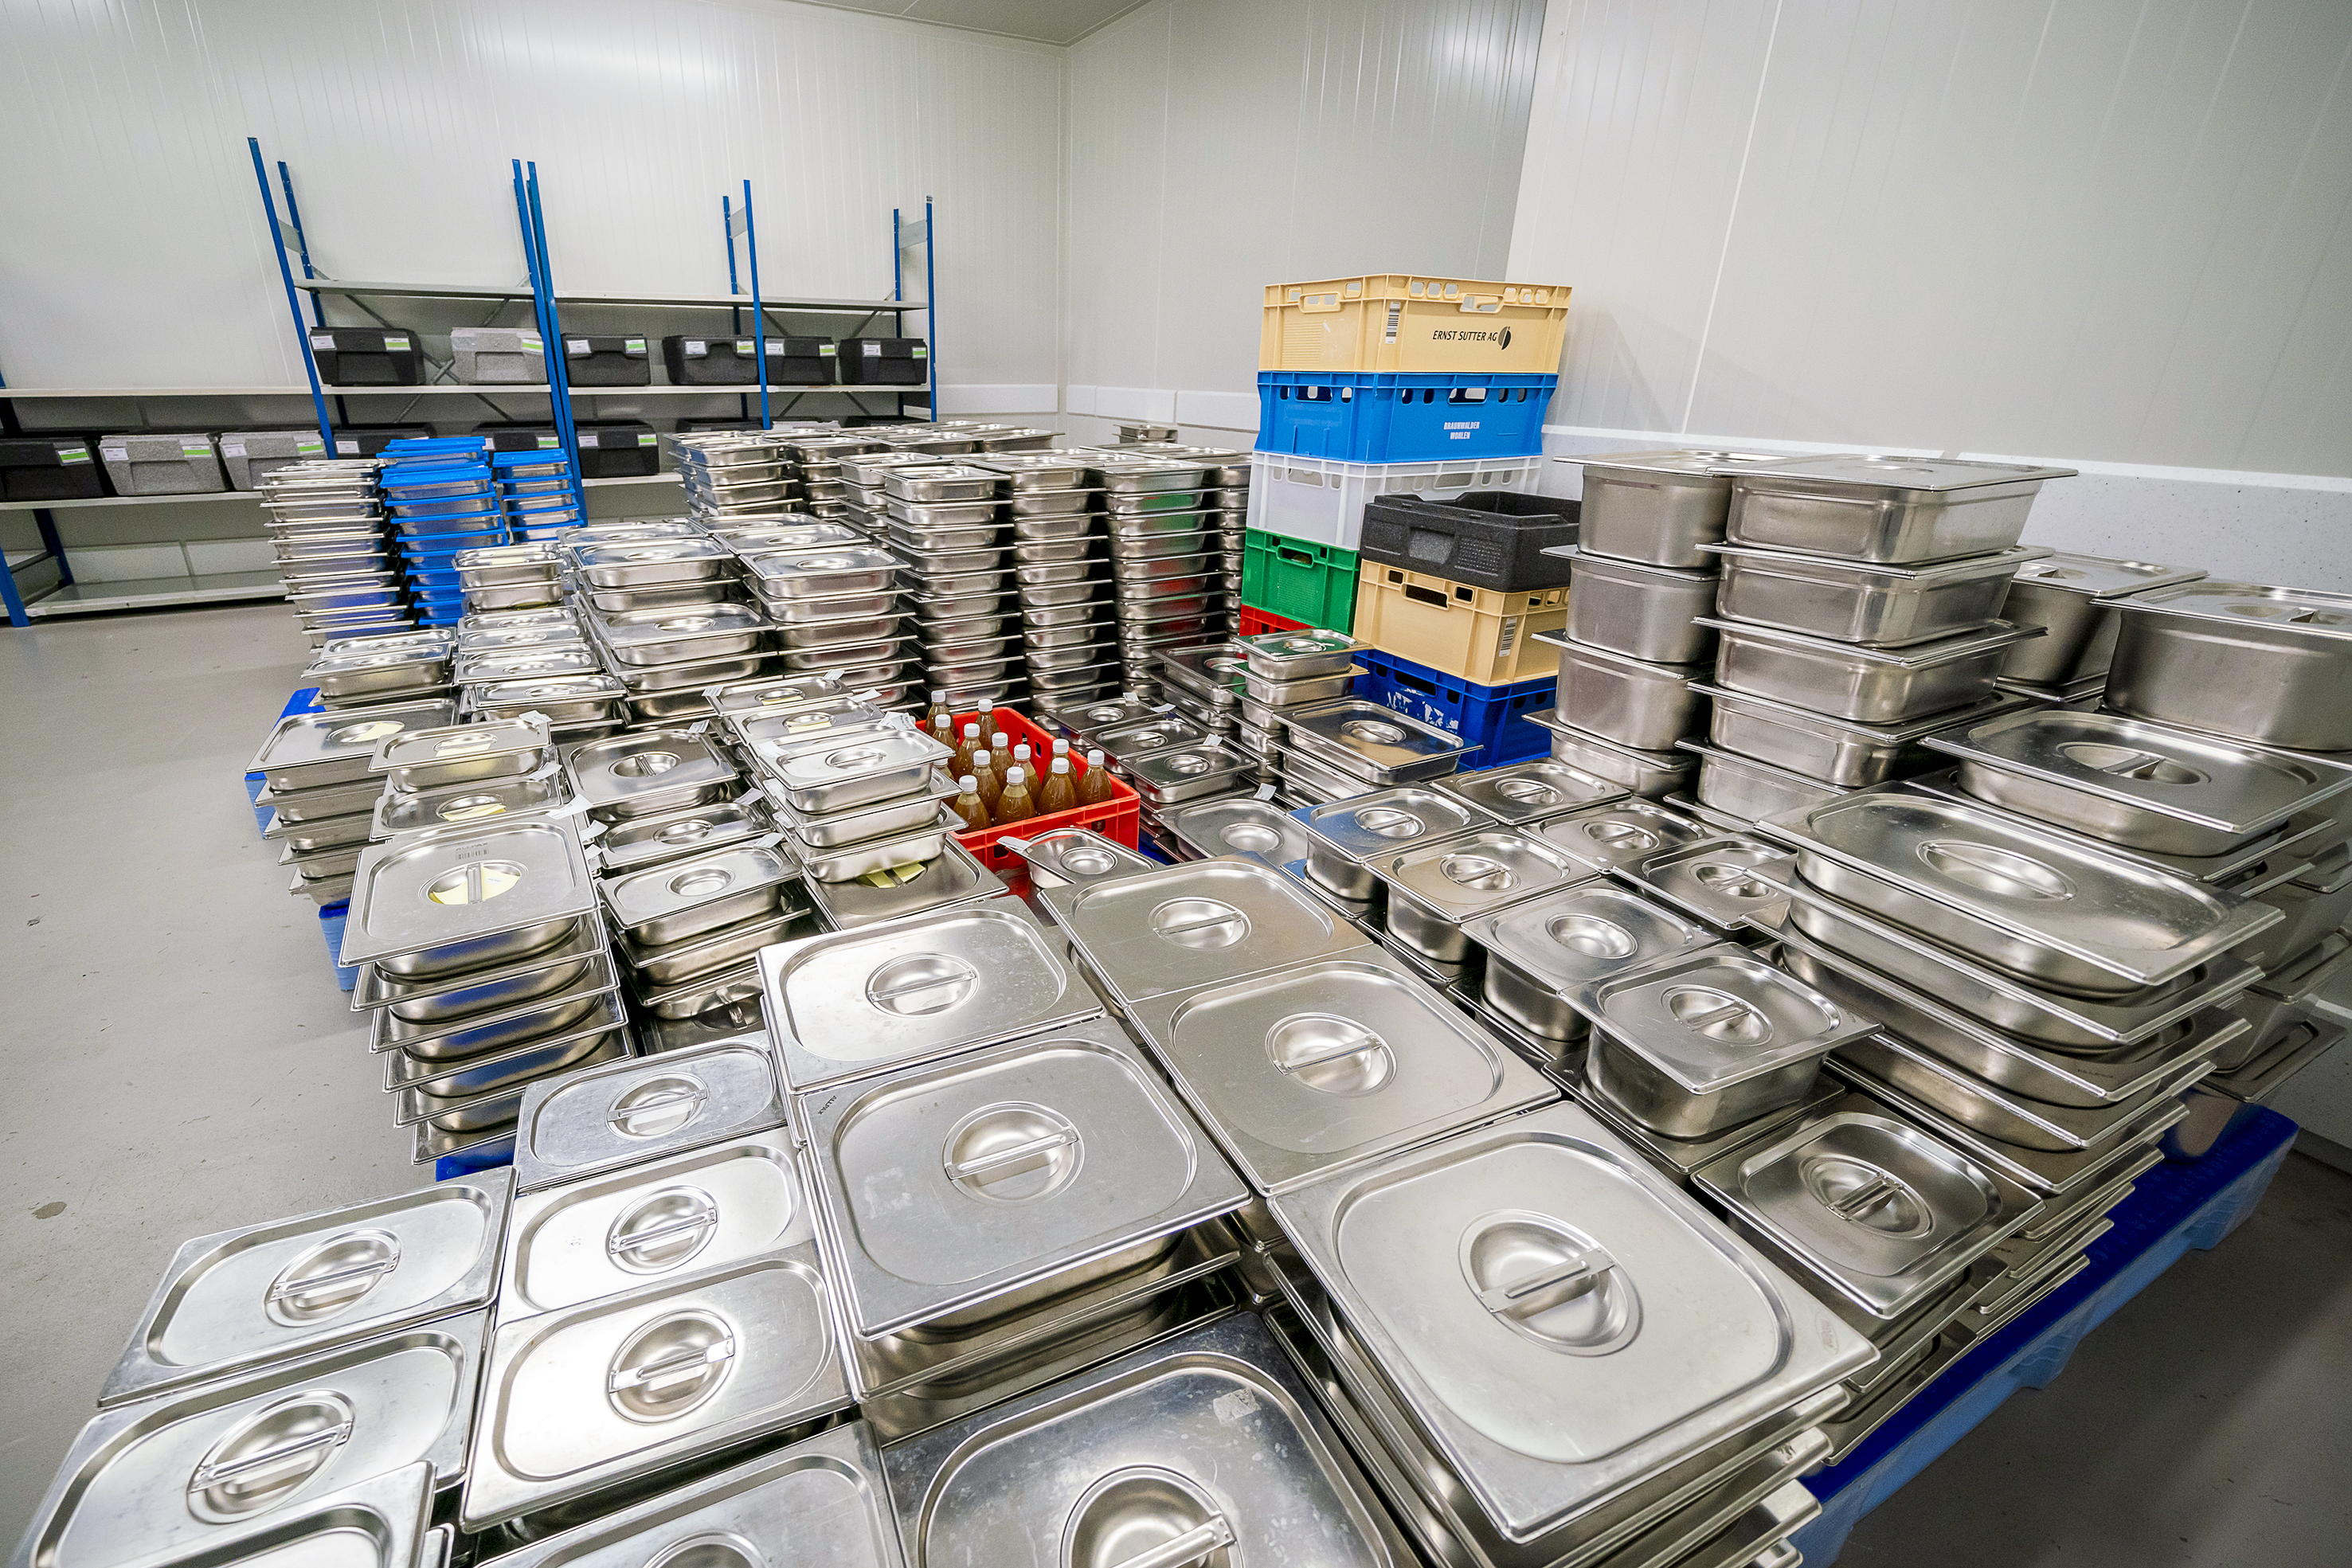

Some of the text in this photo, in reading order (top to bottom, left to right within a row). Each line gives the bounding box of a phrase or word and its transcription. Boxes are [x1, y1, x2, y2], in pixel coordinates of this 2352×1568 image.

[1432, 330, 1498, 342] ERNST SUTTER AG
[1443, 421, 1481, 430] BRAUNWALDER
[817, 1095, 837, 1115] ALLPAX
